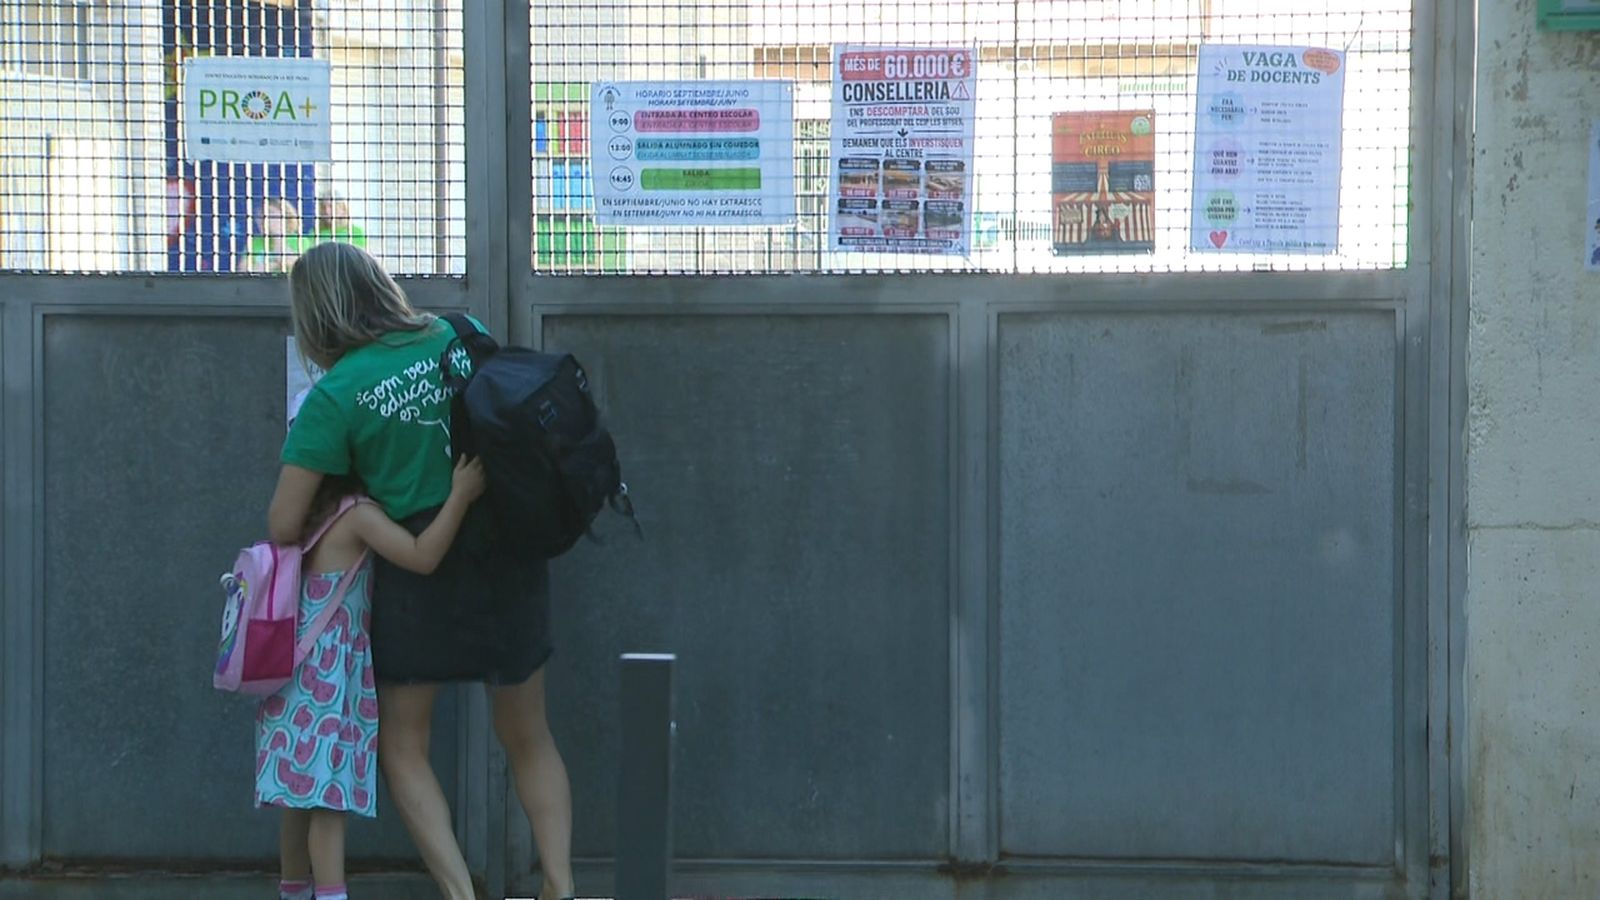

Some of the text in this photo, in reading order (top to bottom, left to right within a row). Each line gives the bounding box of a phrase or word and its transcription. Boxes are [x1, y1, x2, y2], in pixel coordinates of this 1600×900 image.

[844, 54, 866, 72] MÉS
[867, 58, 881, 71] DE
[1242, 51, 1298, 68] VAGA
[1227, 69, 1321, 84] DE DOCENTS
[635, 89, 672, 98] HORARIO
[842, 80, 951, 102] CONSELLERIA
[678, 110, 688, 118] AL
[689, 110, 718, 118] CENTRO
[720, 110, 753, 118] ESCOLAR
[849, 108, 864, 117] ENS
[931, 107, 944, 115] DEL
[946, 107, 960, 115] SOU
[612, 117, 629, 126] 9:00
[723, 141, 759, 149] COMEDOR
[842, 138, 879, 148] DEMANEM
[880, 138, 894, 148] QUE
[895, 138, 908, 147] ELS
[884, 149, 924, 158] AL CENTRE
[602, 198, 612, 206] EN
[614, 198, 685, 207] SEPTIEMBRE/JUNIO
[688, 198, 700, 206] NO
[702, 198, 718, 206] HAY
[624, 210, 680, 218] SETEMBRE/JUNY
[363, 375, 403, 410] Som
[403, 357, 440, 381] veu
